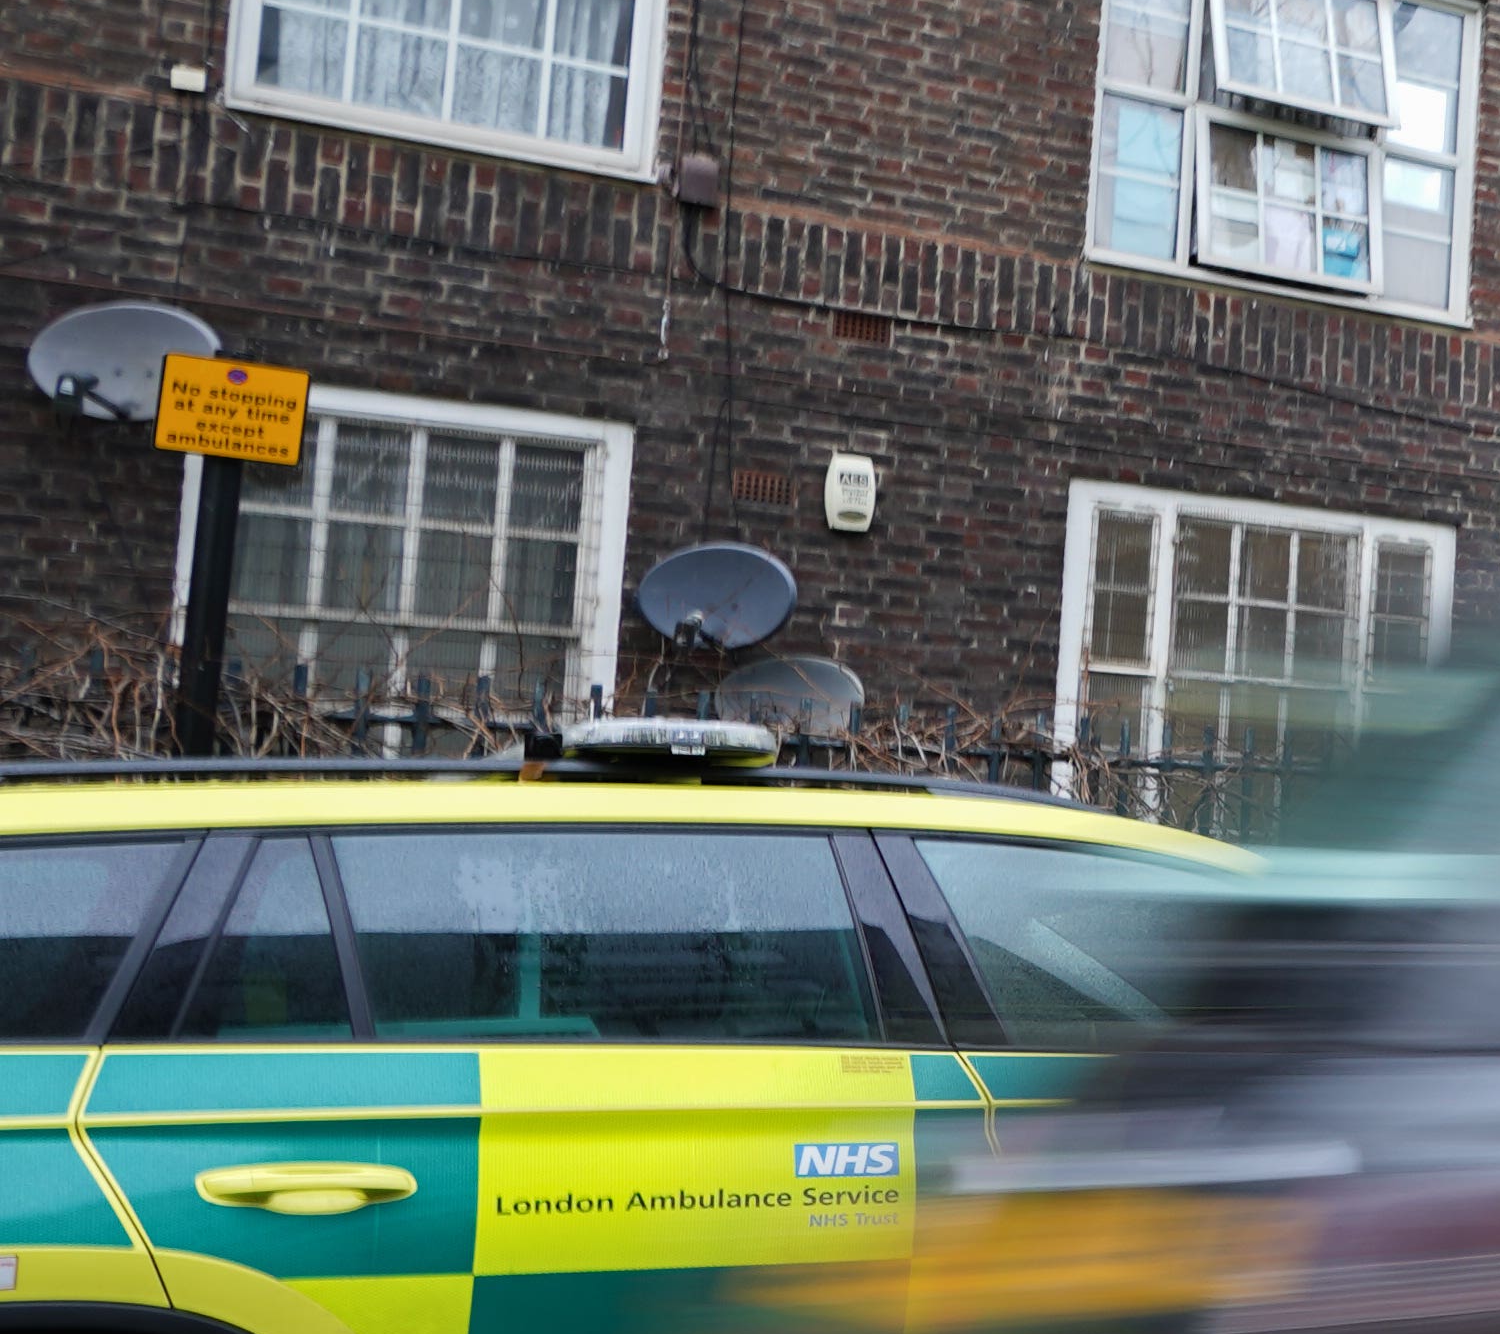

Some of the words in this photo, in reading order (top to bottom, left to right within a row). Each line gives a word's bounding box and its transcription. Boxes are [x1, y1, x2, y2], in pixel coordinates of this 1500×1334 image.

[172, 380, 201, 397] No
[209, 386, 297, 412] stopping
[174, 399, 195, 412] at
[202, 404, 238, 420] any
[247, 408, 290, 425] time
[196, 420, 265, 439] except
[166, 433, 289, 458] ambulances
[797, 1145, 896, 1176] NHS
[496, 1192, 614, 1216] London
[625, 1186, 792, 1211] Ambulance
[803, 1184, 900, 1207] Service
[808, 1212, 848, 1228] NHS
[855, 1210, 900, 1227] Trust
